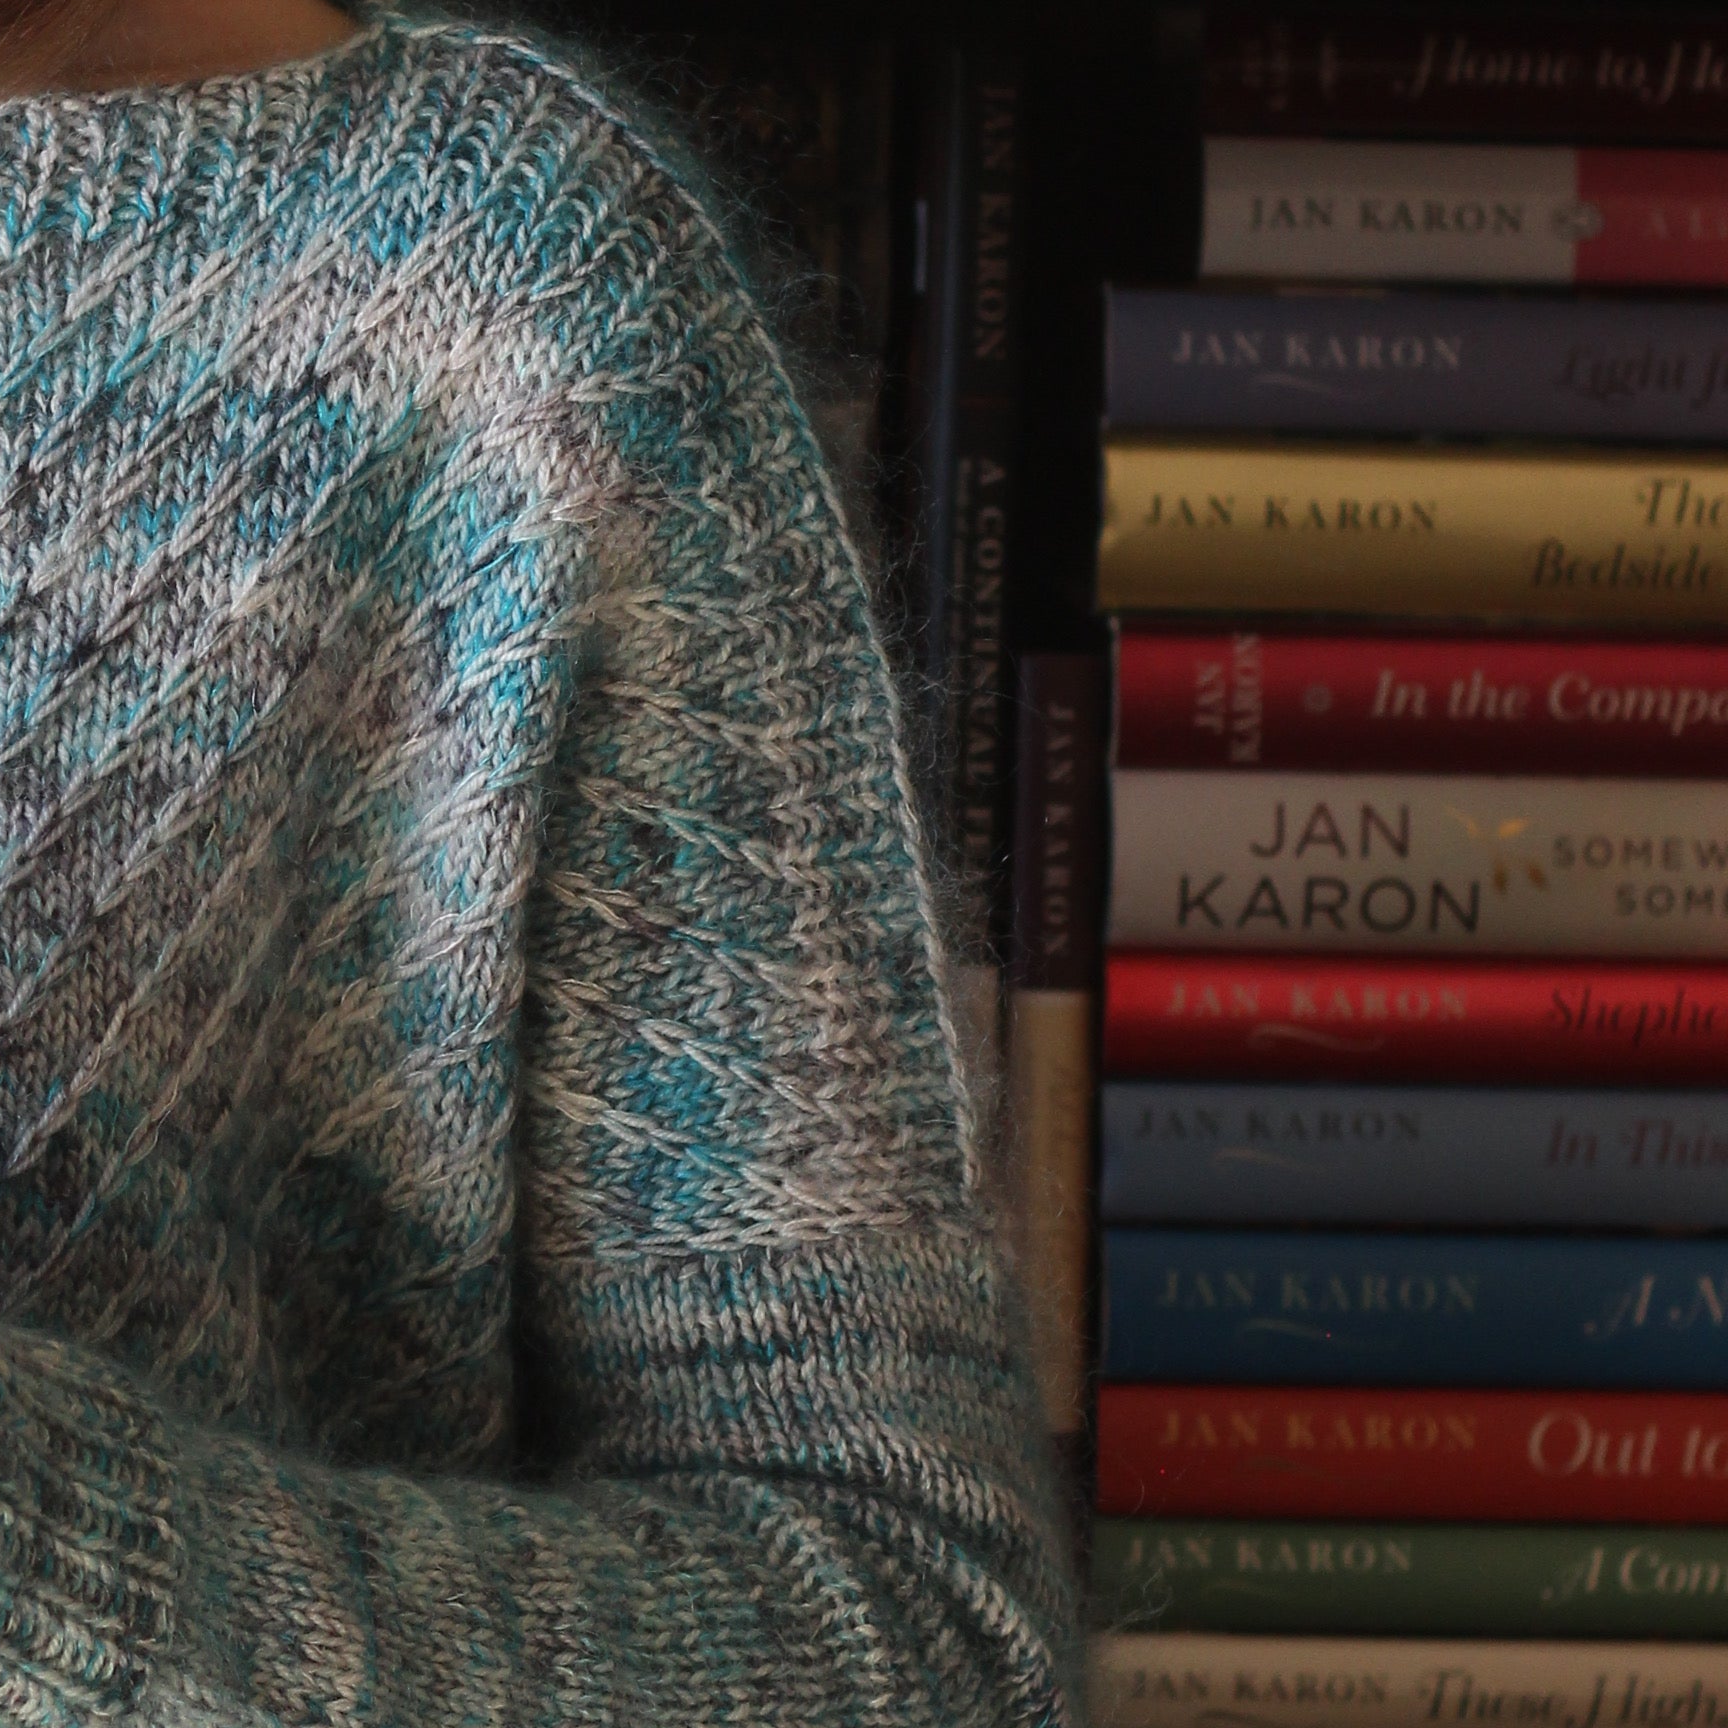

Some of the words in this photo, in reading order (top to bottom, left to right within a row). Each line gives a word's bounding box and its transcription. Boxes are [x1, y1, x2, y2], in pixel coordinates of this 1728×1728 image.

[1249, 196, 1336, 233] JAN
[1359, 197, 1525, 236] KARON
[1170, 329, 1263, 368] JAN
[1283, 331, 1463, 372] KARON
[1145, 493, 1236, 528] JAN
[1262, 495, 1438, 534] KARON
[1529, 537, 1716, 594] Bedside
[1194, 661, 1226, 736] JAN
[1231, 632, 1264, 762] KARON
[1371, 670, 1428, 721] In
[1447, 670, 1531, 721] the
[1249, 800, 1412, 860] JAN
[1175, 874, 1482, 936] KARON
[1168, 983, 1263, 1019] JAN
[1285, 984, 1471, 1024] KARON
[1133, 1107, 1226, 1141] JAN
[1244, 1108, 1424, 1144] KARON
[1158, 1270, 1257, 1310] JAN
[1280, 1271, 1480, 1314] KARON
[1158, 1408, 1263, 1449] JAN
[1283, 1408, 1479, 1453] KARON
[1526, 1406, 1661, 1480] Out
[1122, 1536, 1214, 1571] JAN
[1234, 1537, 1413, 1574] KARON
[1128, 1670, 1210, 1703] JAN
[1231, 1671, 1387, 1706] KARON
